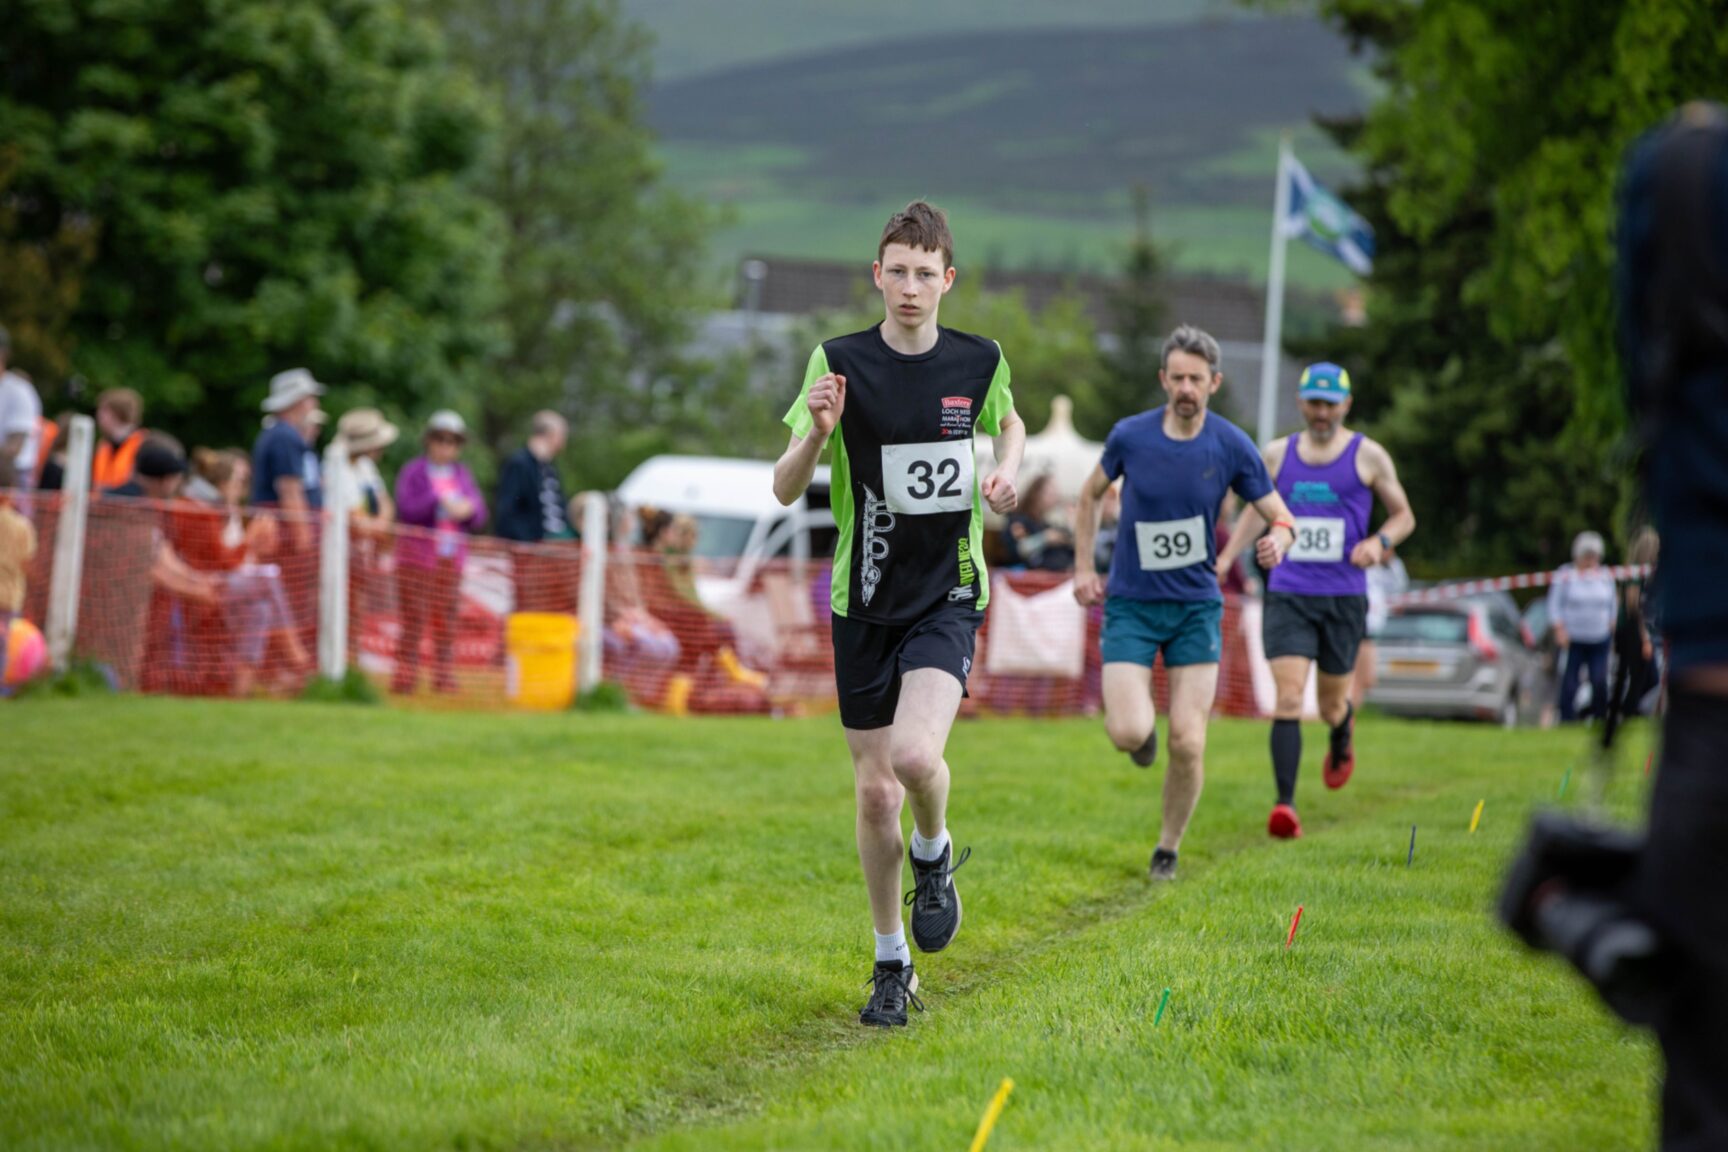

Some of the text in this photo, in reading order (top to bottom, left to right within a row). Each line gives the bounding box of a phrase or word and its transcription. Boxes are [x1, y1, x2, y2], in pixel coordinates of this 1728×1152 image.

[942, 415, 971, 424] MARATHON
[907, 458, 962, 500] 32
[1153, 532, 1191, 559] 39
[1300, 528, 1331, 553] 38
